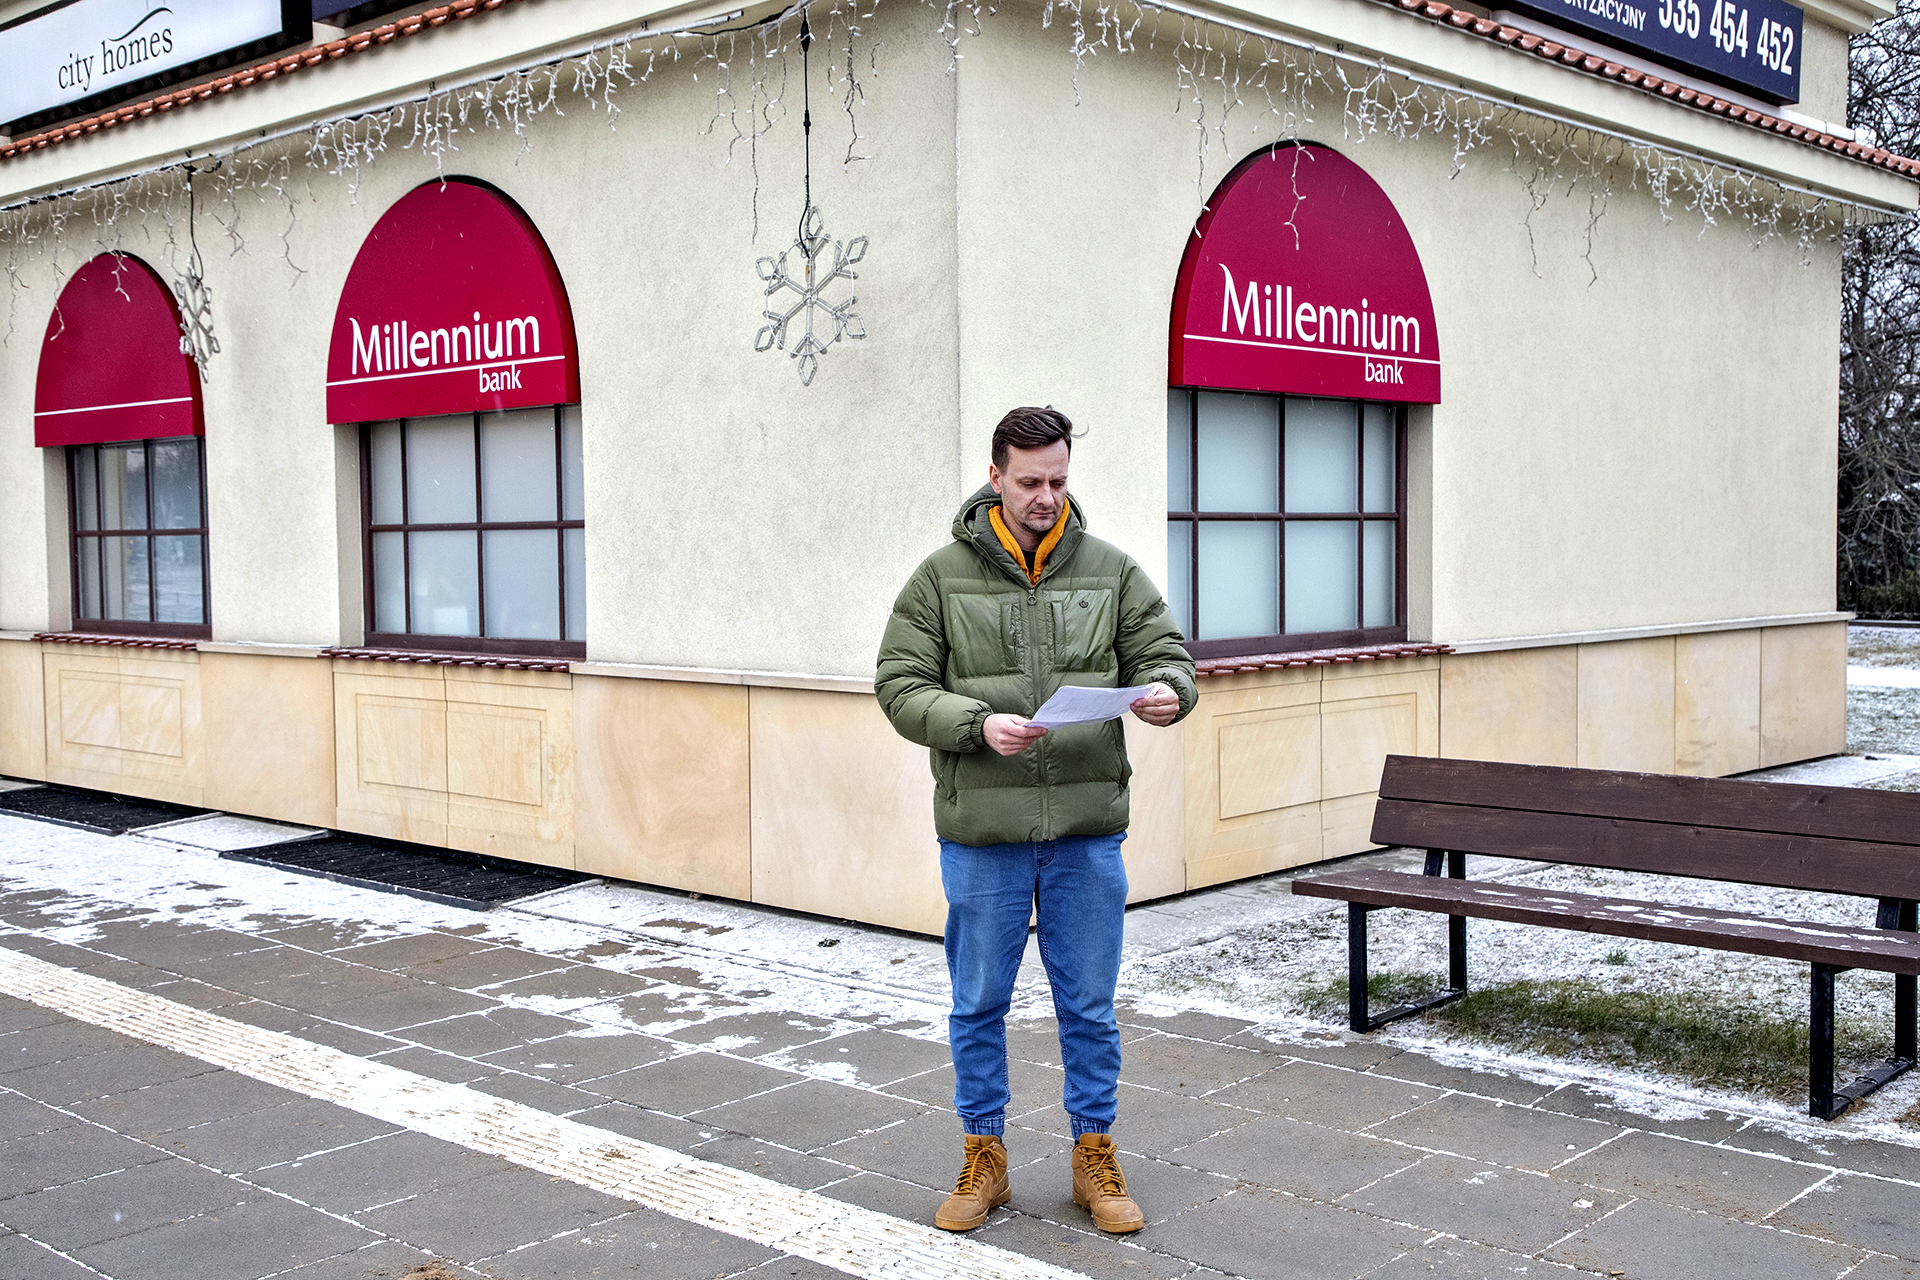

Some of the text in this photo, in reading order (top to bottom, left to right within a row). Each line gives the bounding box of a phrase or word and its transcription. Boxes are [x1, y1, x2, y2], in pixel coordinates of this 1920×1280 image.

[58, 27, 173, 92] city homes
[1658, 0, 1794, 76] 535 454 452
[1219, 263, 1420, 354] Millennium
[349, 311, 540, 375] Millennium
[1365, 355, 1404, 385] bank
[479, 364, 522, 393] bank
